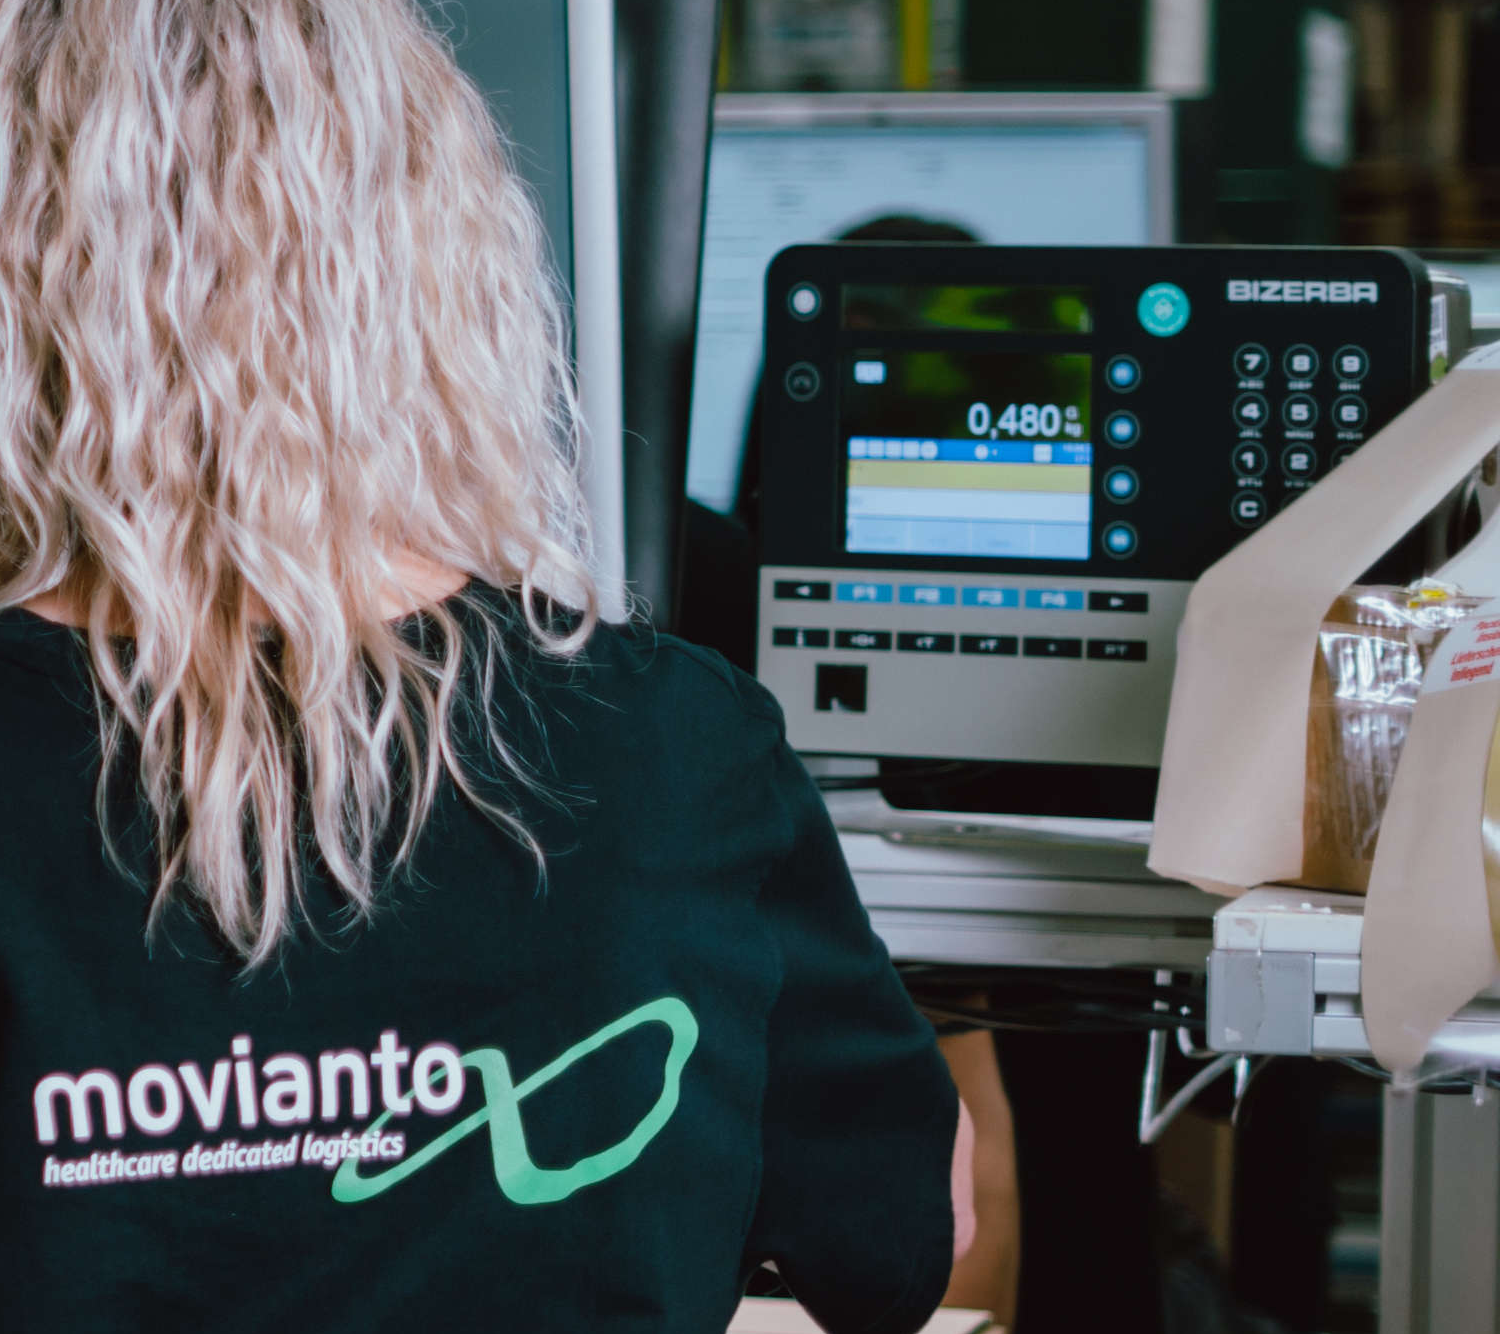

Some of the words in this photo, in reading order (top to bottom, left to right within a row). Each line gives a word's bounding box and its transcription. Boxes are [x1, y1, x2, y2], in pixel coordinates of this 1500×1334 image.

[1227, 279, 1378, 303] BIZERBA
[1243, 354, 1261, 371] 7
[1292, 355, 1311, 372] 8
[1342, 355, 1361, 373] 9
[967, 402, 1062, 440] 0,480
[1241, 403, 1261, 420] 4
[1290, 404, 1309, 421] 5
[1340, 405, 1359, 422] 6
[1240, 452, 1255, 469] 1
[1290, 453, 1309, 471] 2
[1239, 500, 1259, 518] C
[852, 586, 877, 601] F1
[914, 588, 941, 603] F2
[977, 590, 1004, 606] F3
[1040, 592, 1067, 608] F4
[33, 1031, 465, 1143] movianto
[43, 1153, 176, 1186] healthcare
[181, 1135, 300, 1173] dedicated
[302, 1130, 405, 1169] logistics
